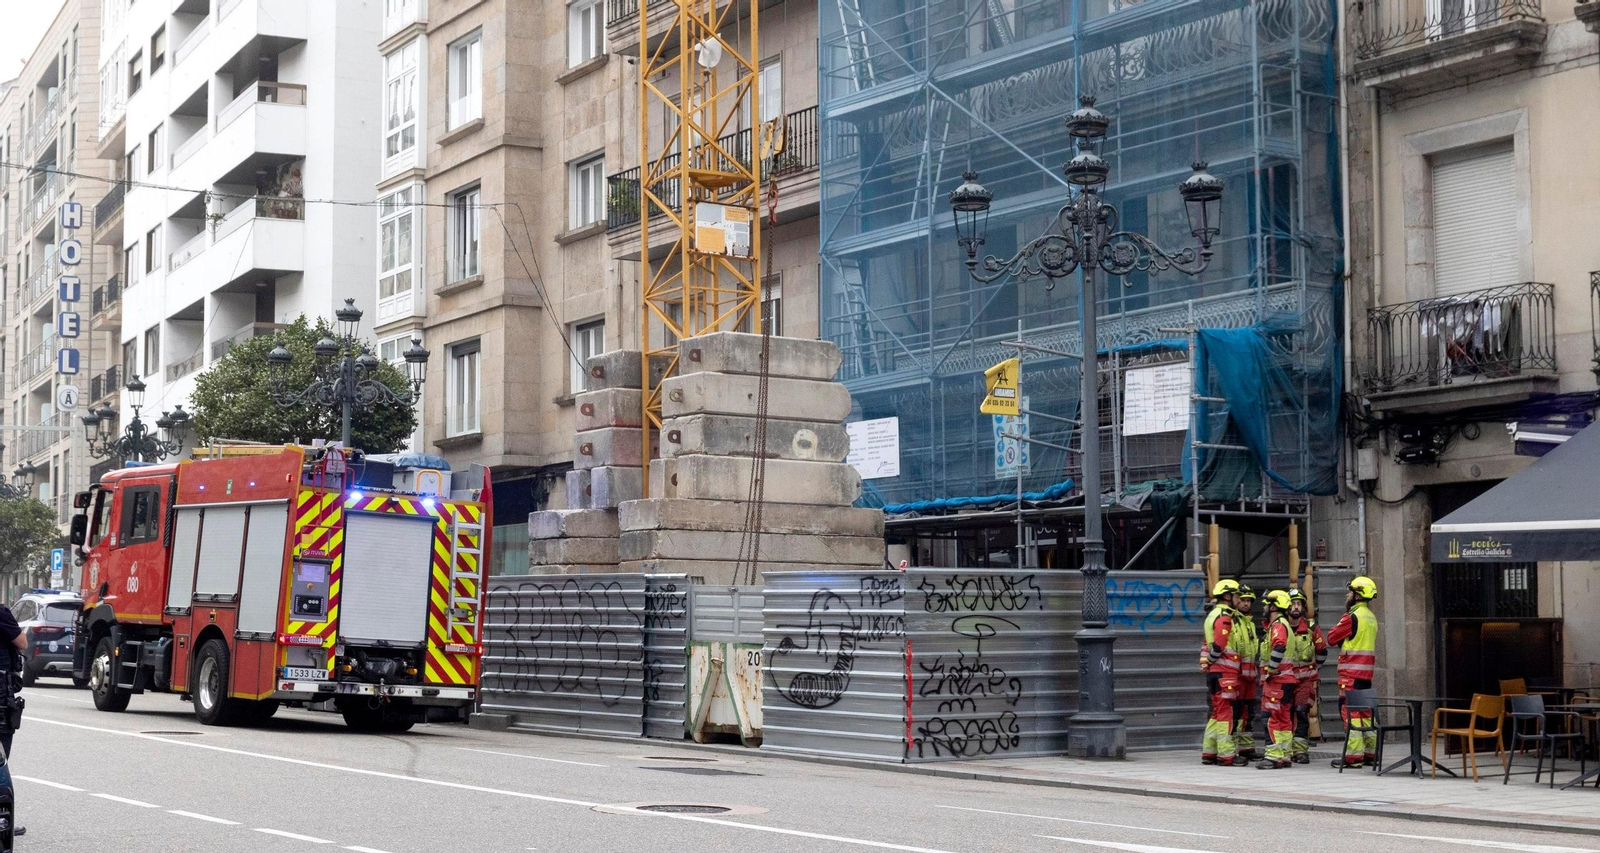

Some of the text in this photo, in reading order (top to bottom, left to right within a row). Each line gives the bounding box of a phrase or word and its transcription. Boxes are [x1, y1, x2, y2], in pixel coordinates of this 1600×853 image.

[62, 203, 82, 374] HOTEL
[1462, 547, 1506, 556] Estrella Galicia
[54, 552, 61, 570] P
[126, 576, 139, 593] 080
[747, 650, 761, 667] 20
[290, 668, 310, 678] 1533
